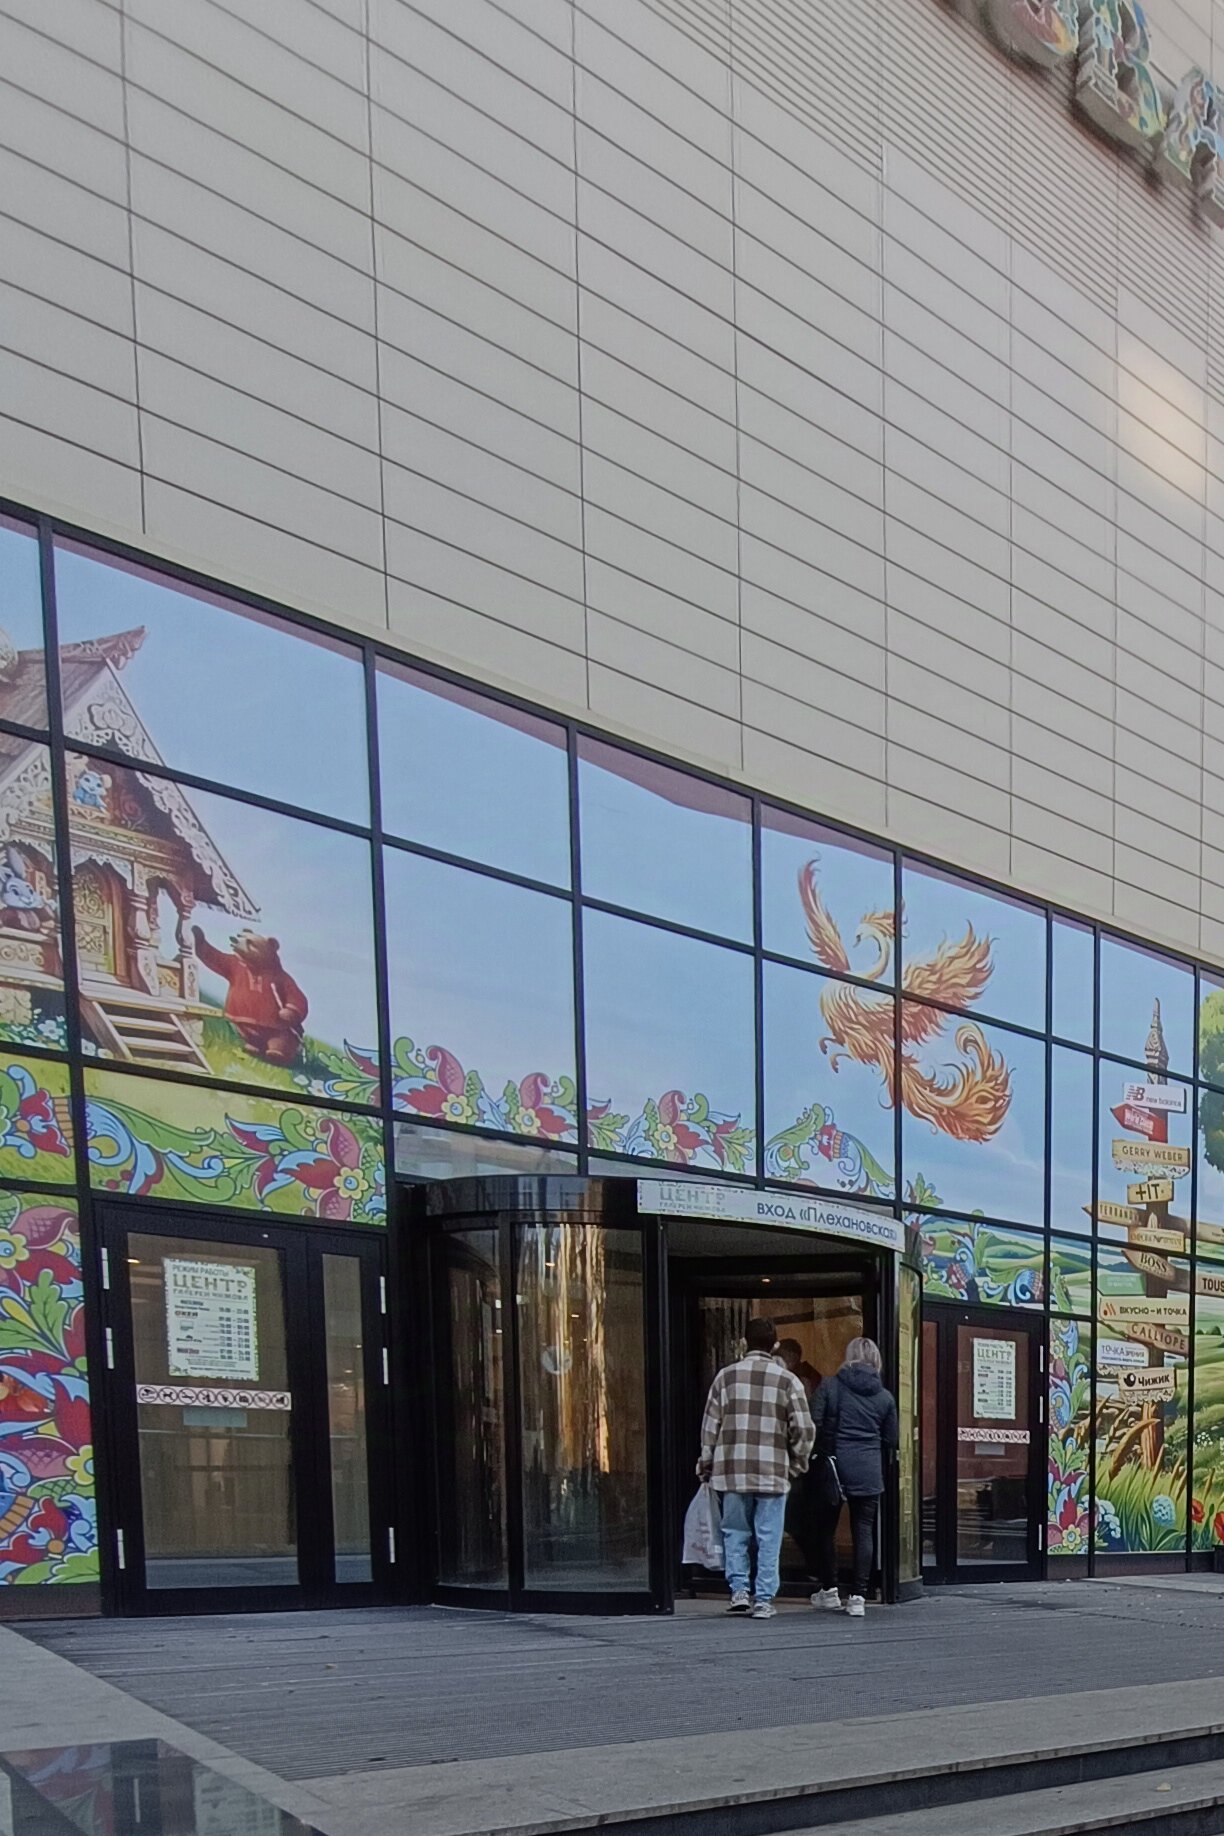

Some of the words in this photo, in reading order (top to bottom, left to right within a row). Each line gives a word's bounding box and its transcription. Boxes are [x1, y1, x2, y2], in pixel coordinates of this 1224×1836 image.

[1122, 1145, 1151, 1158] GERRY
[1153, 1149, 1183, 1162] WEBER
[659, 1186, 725, 1206] ЦЕНТР
[1140, 1252, 1168, 1274] BOSS
[172, 1273, 248, 1293] ЦЕНТР
[1119, 1306, 1150, 1315] ВКУСНО
[1163, 1307, 1187, 1316] ТОЧКА
[1131, 1323, 1185, 1351] CALLIOPE
[1137, 1373, 1170, 1388] Чижик
